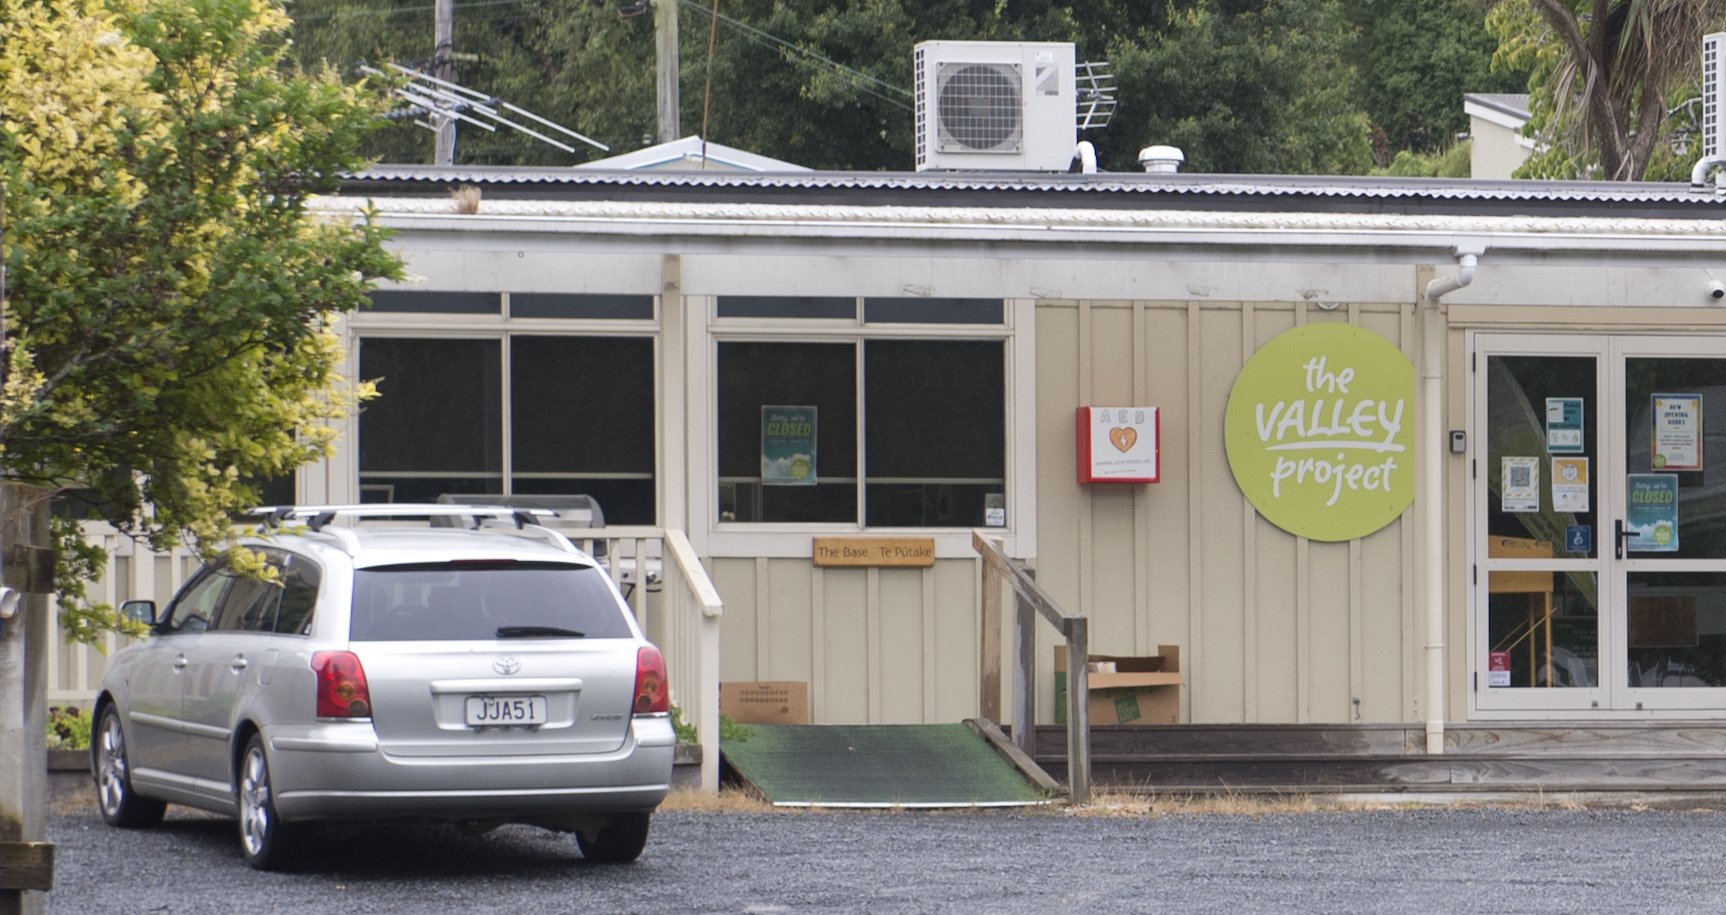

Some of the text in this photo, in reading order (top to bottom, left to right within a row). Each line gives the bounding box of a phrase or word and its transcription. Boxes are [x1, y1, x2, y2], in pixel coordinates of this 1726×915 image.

[1302, 355, 1355, 393] the
[768, 422, 812, 436] CLOSED
[1255, 399, 1404, 453] VALLEY
[1270, 453, 1398, 506] project
[1632, 490, 1673, 503] CLOSED
[819, 546, 933, 558] The Base Te Pūtake
[476, 701, 535, 720] JJA51
